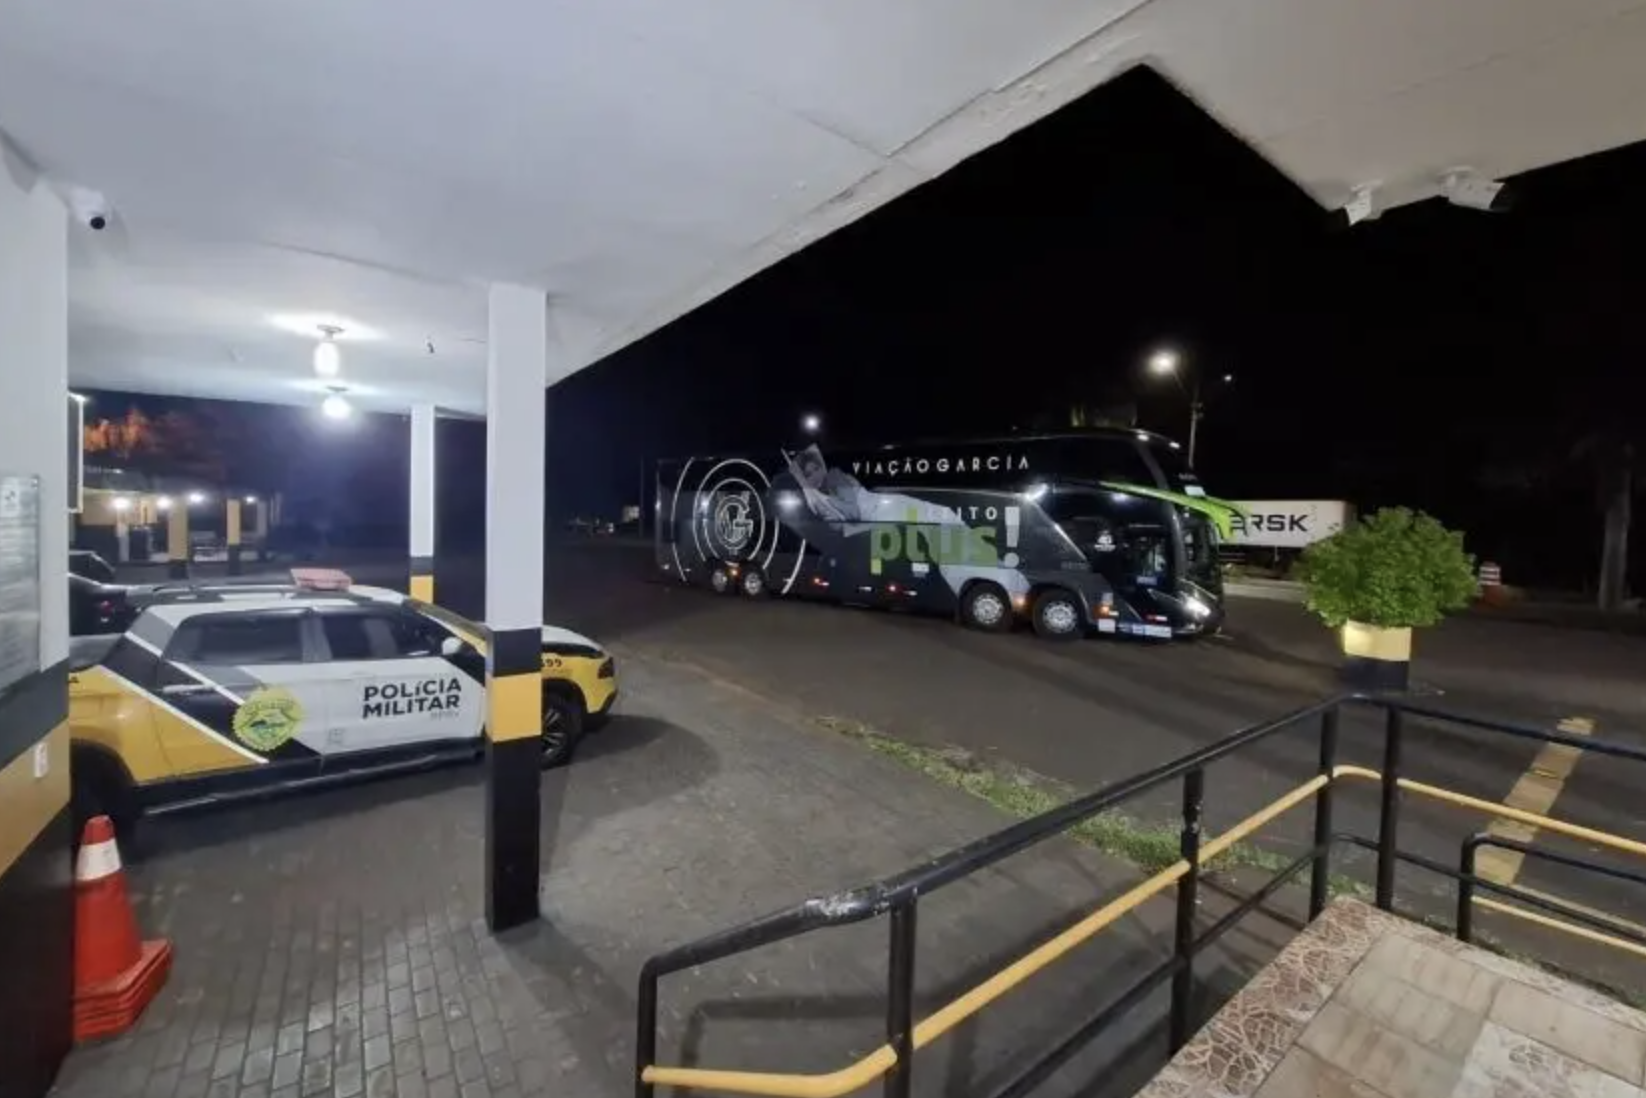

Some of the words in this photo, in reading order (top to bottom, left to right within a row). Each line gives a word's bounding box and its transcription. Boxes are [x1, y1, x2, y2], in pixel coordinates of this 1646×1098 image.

[541, 658, 563, 668] 99
[363, 678, 462, 702] POLÍCIA
[362, 694, 461, 719] MILITAR
